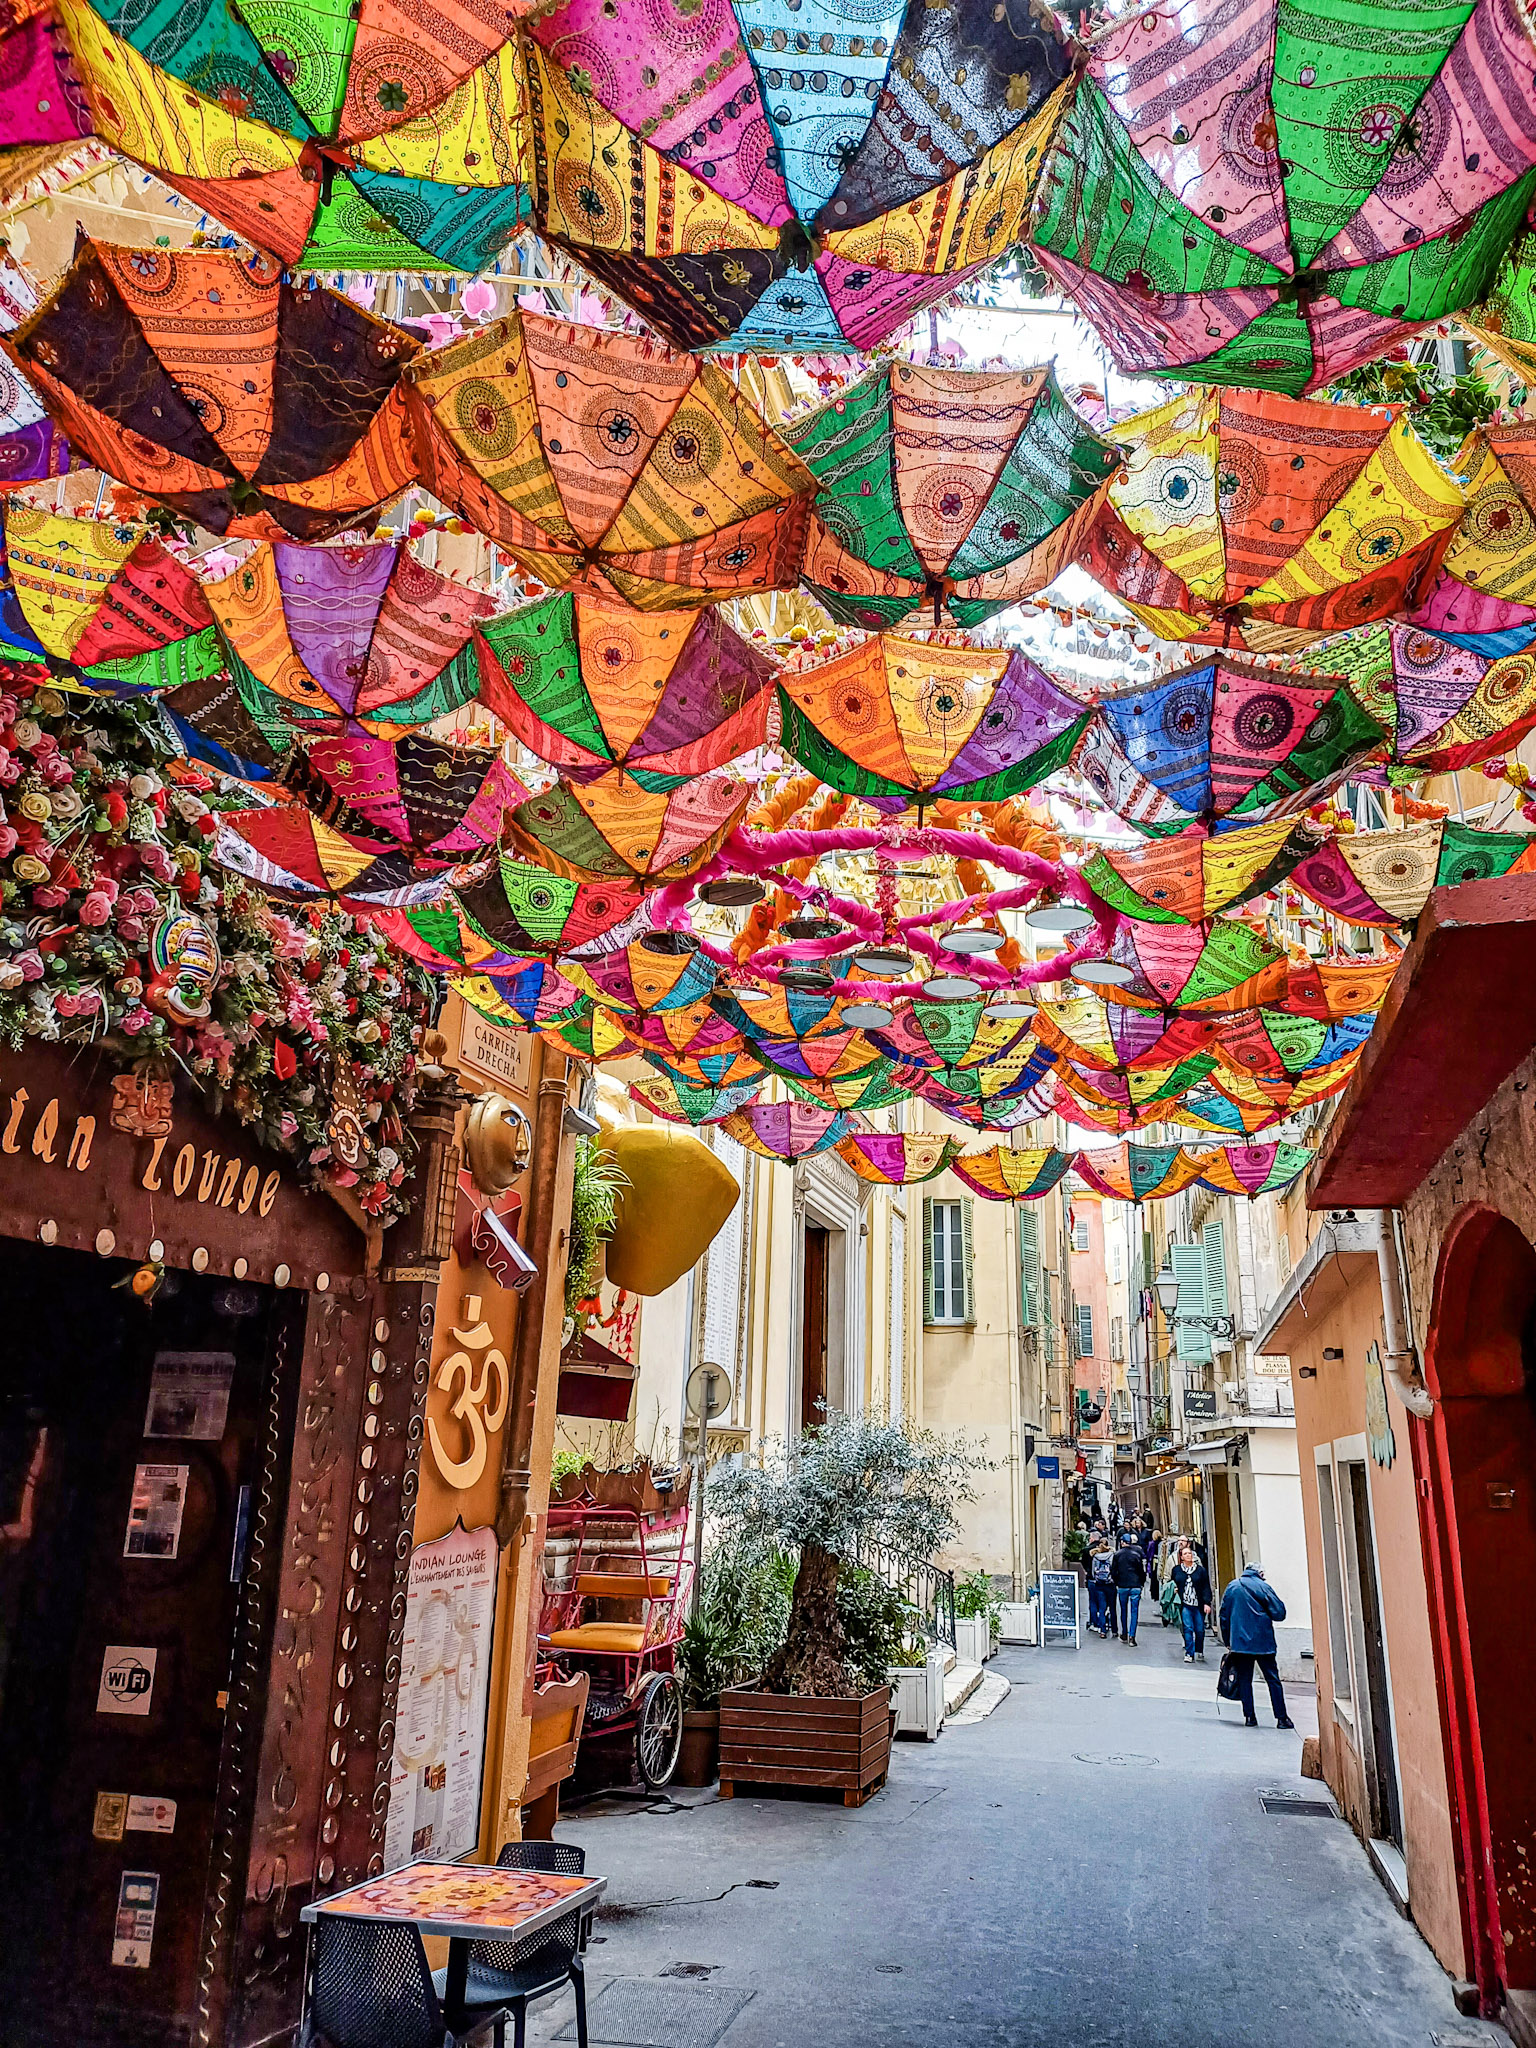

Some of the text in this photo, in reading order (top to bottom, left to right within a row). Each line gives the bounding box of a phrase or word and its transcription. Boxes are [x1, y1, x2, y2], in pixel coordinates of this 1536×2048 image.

[474, 1025, 522, 1064] CARRIERA
[476, 1045, 516, 1079] DRECHA
[411, 1548, 487, 1571] INDIAN LOUNGE
[410, 1563, 486, 1585] L'ENCHANTEMENT DES SAVEURS
